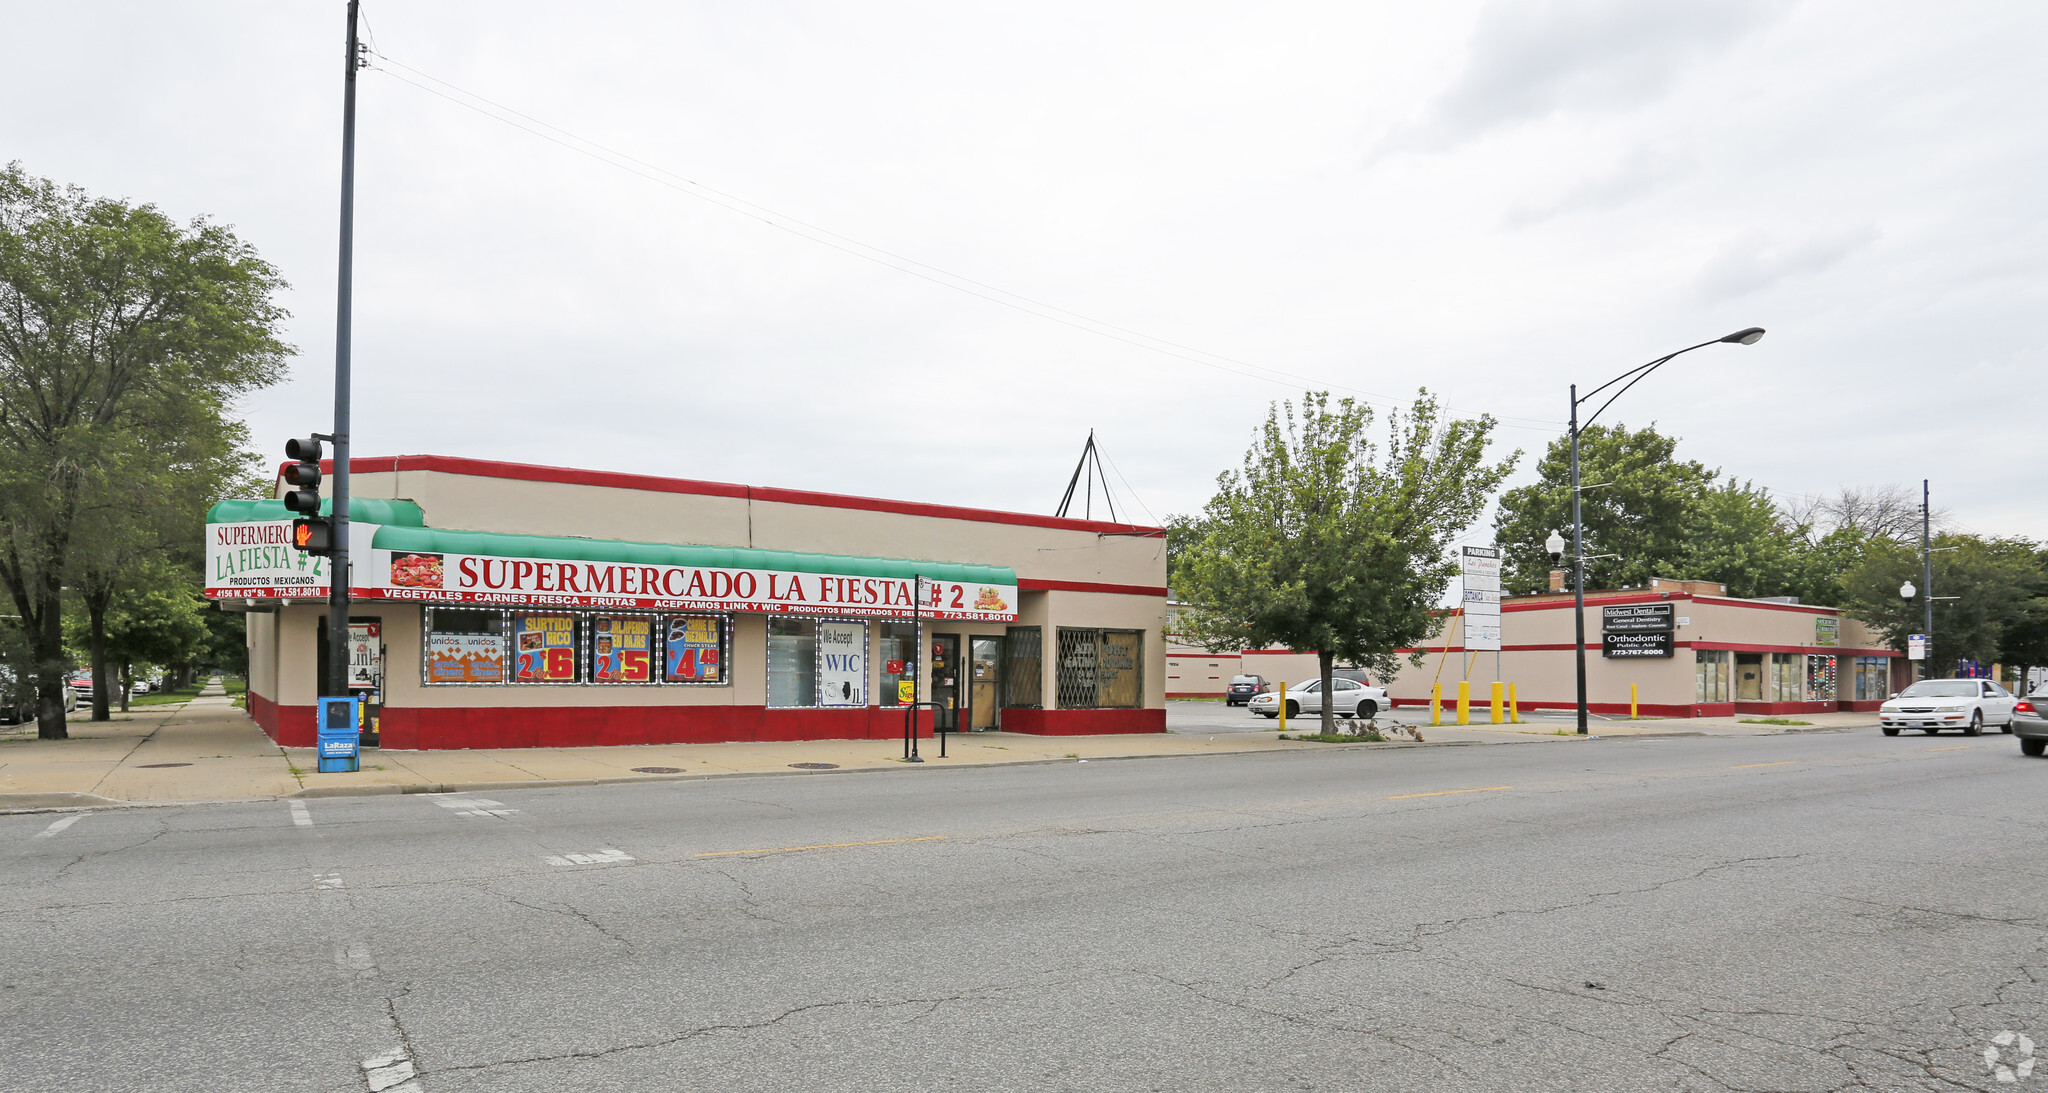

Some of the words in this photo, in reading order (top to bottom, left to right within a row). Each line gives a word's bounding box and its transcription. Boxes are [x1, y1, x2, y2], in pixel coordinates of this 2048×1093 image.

[218, 525, 294, 545] SUPERMERC
[1468, 548, 1495, 557] PARKING
[216, 552, 235, 581] LA
[239, 546, 291, 572] FIESTA
[313, 556, 322, 576] 2
[230, 577, 270, 585] PRODUCTOS
[274, 576, 314, 585] MEXICANOS
[459, 557, 757, 599] SUPERMERCADO
[768, 574, 806, 601] LA
[819, 576, 913, 606] FIESTA
[930, 584, 942, 607] #
[950, 585, 964, 608] 2
[257, 588, 266, 596] St.
[273, 588, 320, 596] 773.581.8010
[383, 589, 463, 600] VEGETALES
[474, 592, 527, 603] CARNES
[530, 594, 580, 605] FRESCA
[590, 597, 636, 607] FRUTAS
[654, 600, 720, 610] ACEPTAMOS
[724, 602, 748, 610] LINK
[788, 606, 839, 614] PRODUCTOS
[841, 608, 892, 616] IMPORTADOS
[943, 611, 1013, 621] 773.581.8010
[612, 634, 622, 648] EN
[824, 630, 832, 644] We
[833, 630, 852, 647] Accept
[1608, 634, 1666, 642] Orthodontic
[518, 654, 533, 678] 2
[531, 667, 552, 678] for
[597, 656, 611, 679] 2
[609, 668, 628, 680] for
[826, 654, 860, 672] WIC
[433, 668, 464, 676] dinero
[470, 668, 500, 676] dinero
[706, 667, 715, 675] LB
[852, 689, 862, 704] IL
